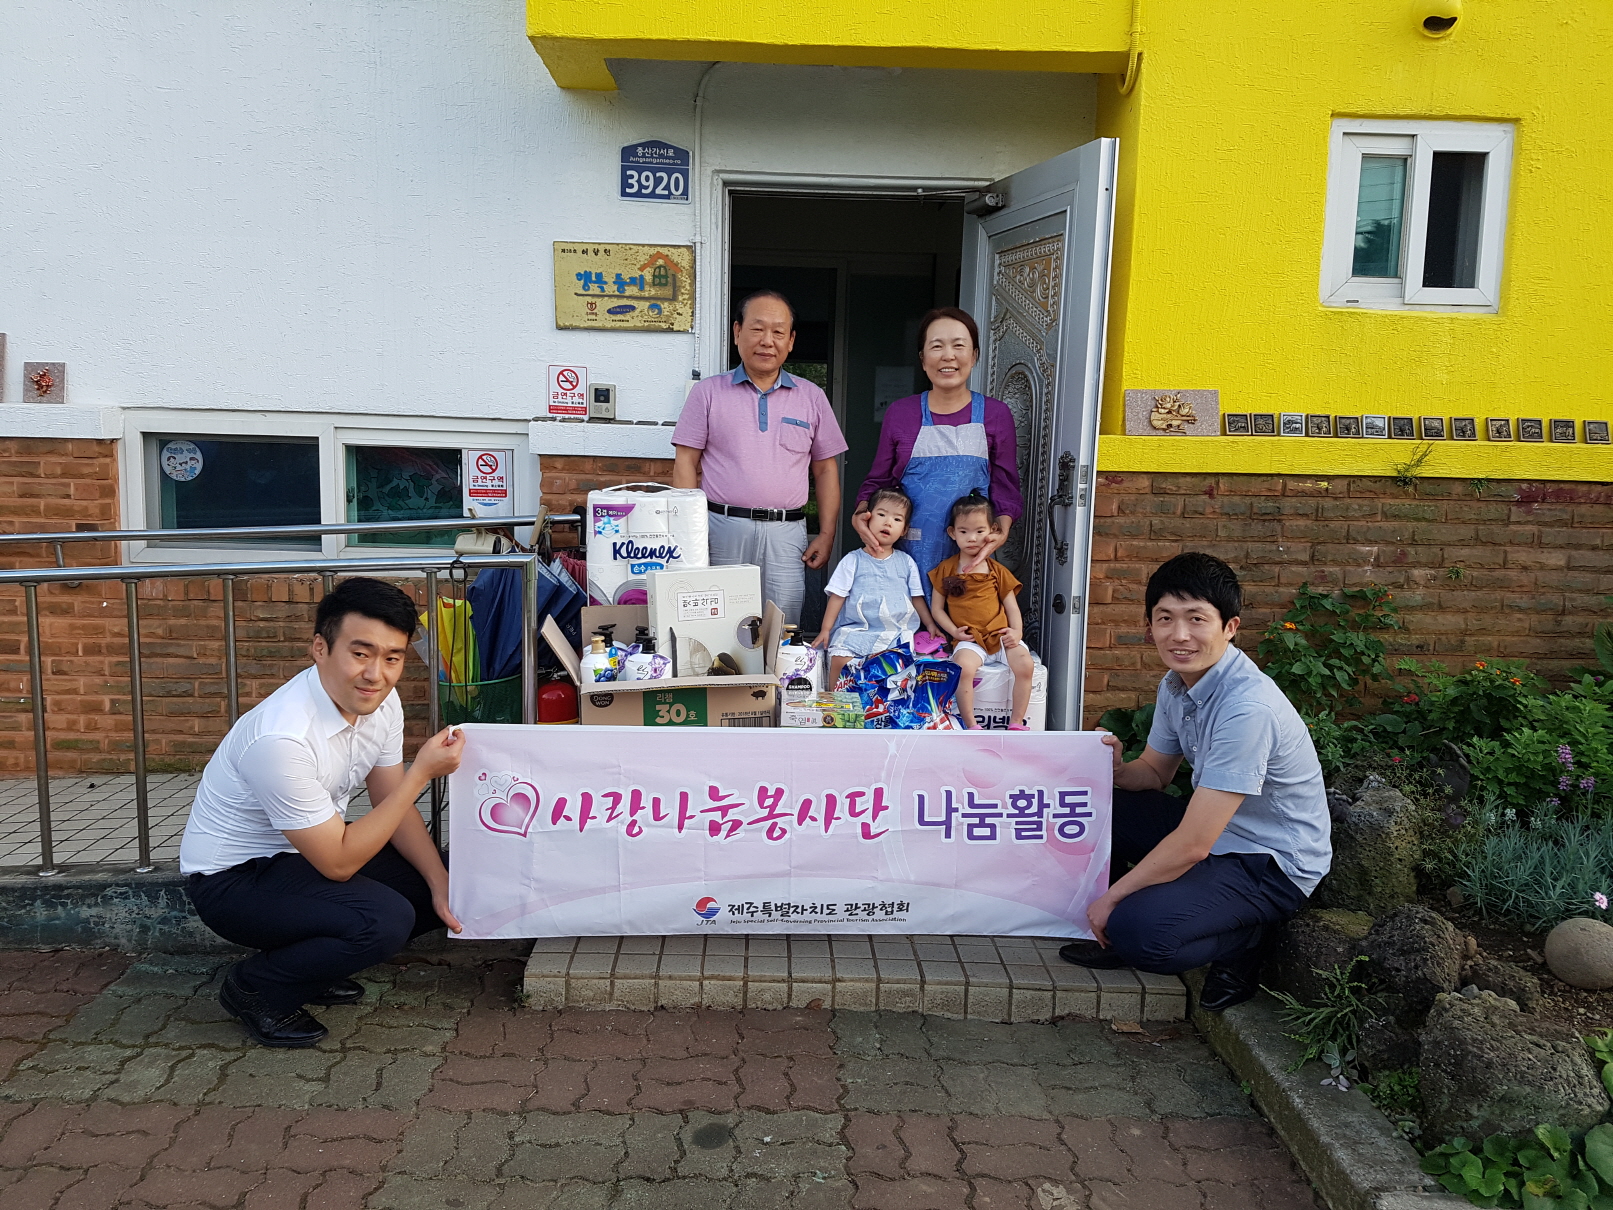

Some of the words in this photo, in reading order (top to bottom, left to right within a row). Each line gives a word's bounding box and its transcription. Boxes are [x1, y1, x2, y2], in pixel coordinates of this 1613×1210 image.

[636, 147, 675, 157] 중산간서로
[629, 156, 681, 164] Jungsanganseo-ro
[625, 170, 684, 195] 3920
[552, 391, 585, 401] 금연구역
[471, 475, 504, 484] 금연구역
[612, 539, 682, 564] Kleenex
[550, 785, 890, 842] 사랑나눔봉사단
[917, 789, 1093, 842] 나눔활동
[727, 901, 838, 918] 제주특별자치도
[843, 900, 911, 917] 관광협회
[696, 919, 717, 927] JTA
